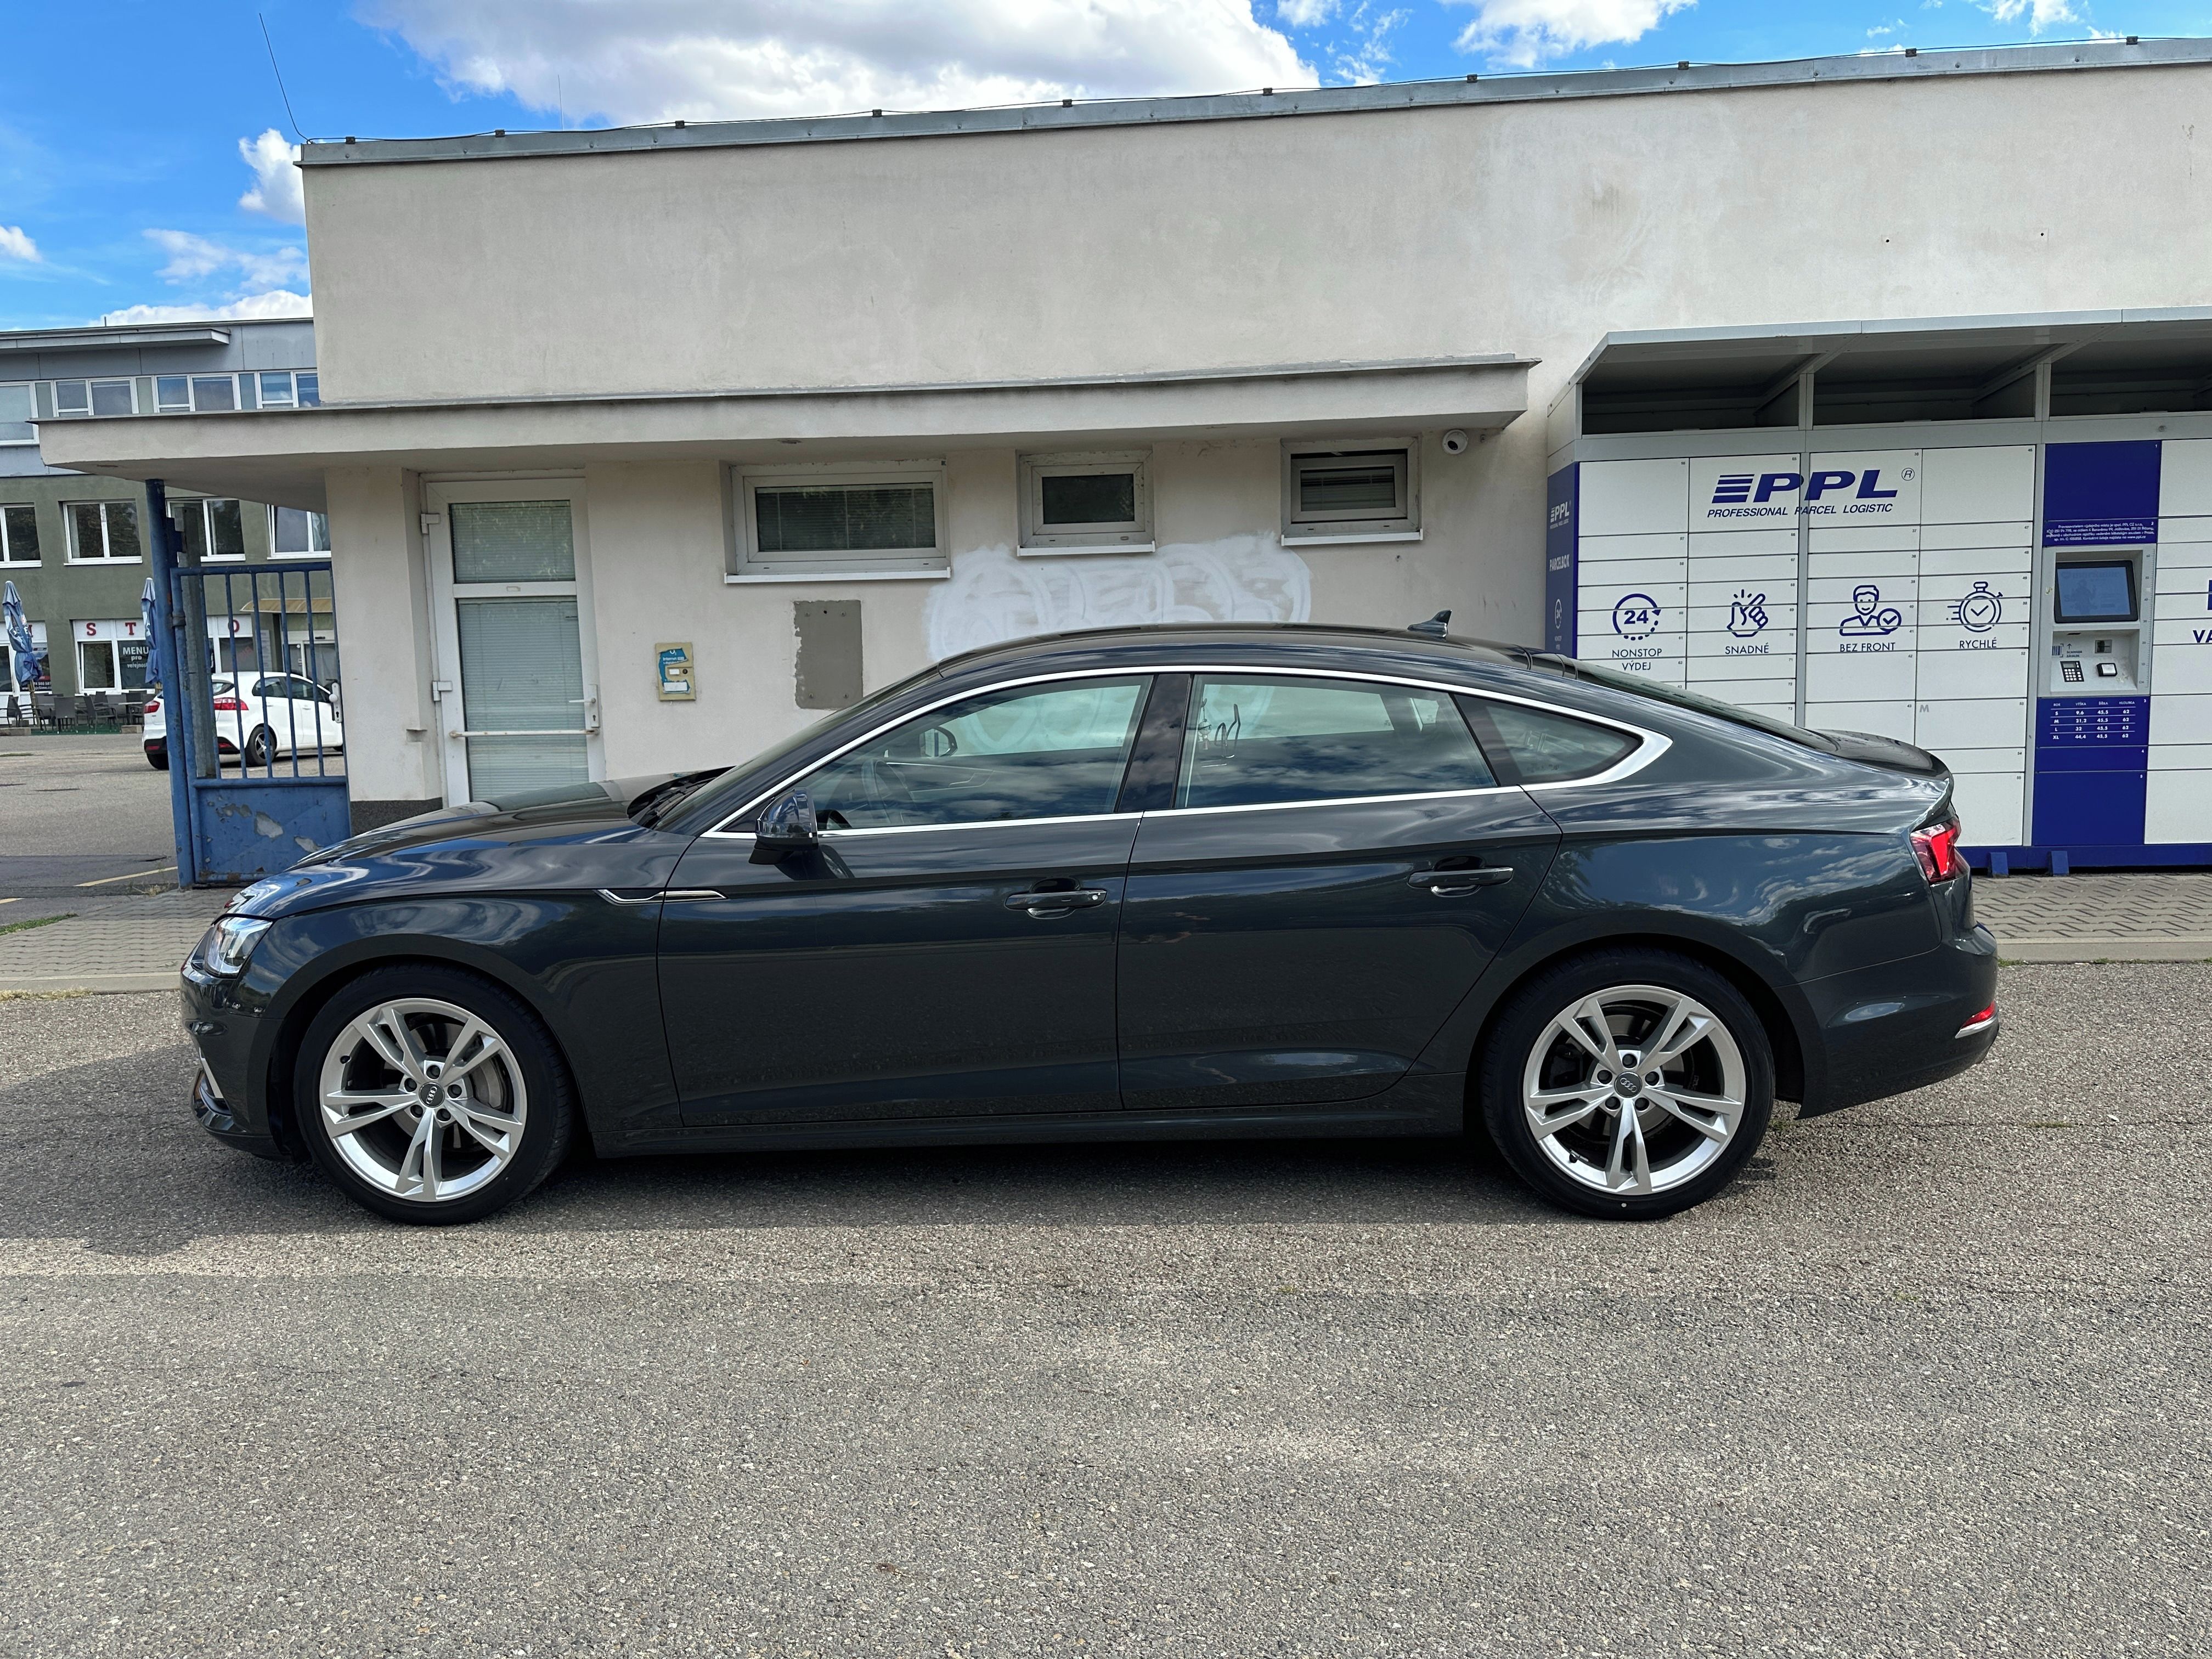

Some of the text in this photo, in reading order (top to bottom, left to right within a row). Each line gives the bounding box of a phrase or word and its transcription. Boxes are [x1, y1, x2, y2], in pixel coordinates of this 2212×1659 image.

[1707, 504, 1893, 518] PROFESSIONAL PARCEL LOGISTIC
[1624, 610, 1649, 624] 24
[1839, 642, 1896, 652] BEZ FRONT
[1959, 637, 1997, 648] RYCHLÉ
[122, 646, 149, 655] MENU
[1612, 648, 1662, 658] NONSTOP
[1725, 643, 1769, 654] SNADNÉ
[1622, 660, 1651, 670] VÝDEJ
[1920, 704, 1929, 713] M
